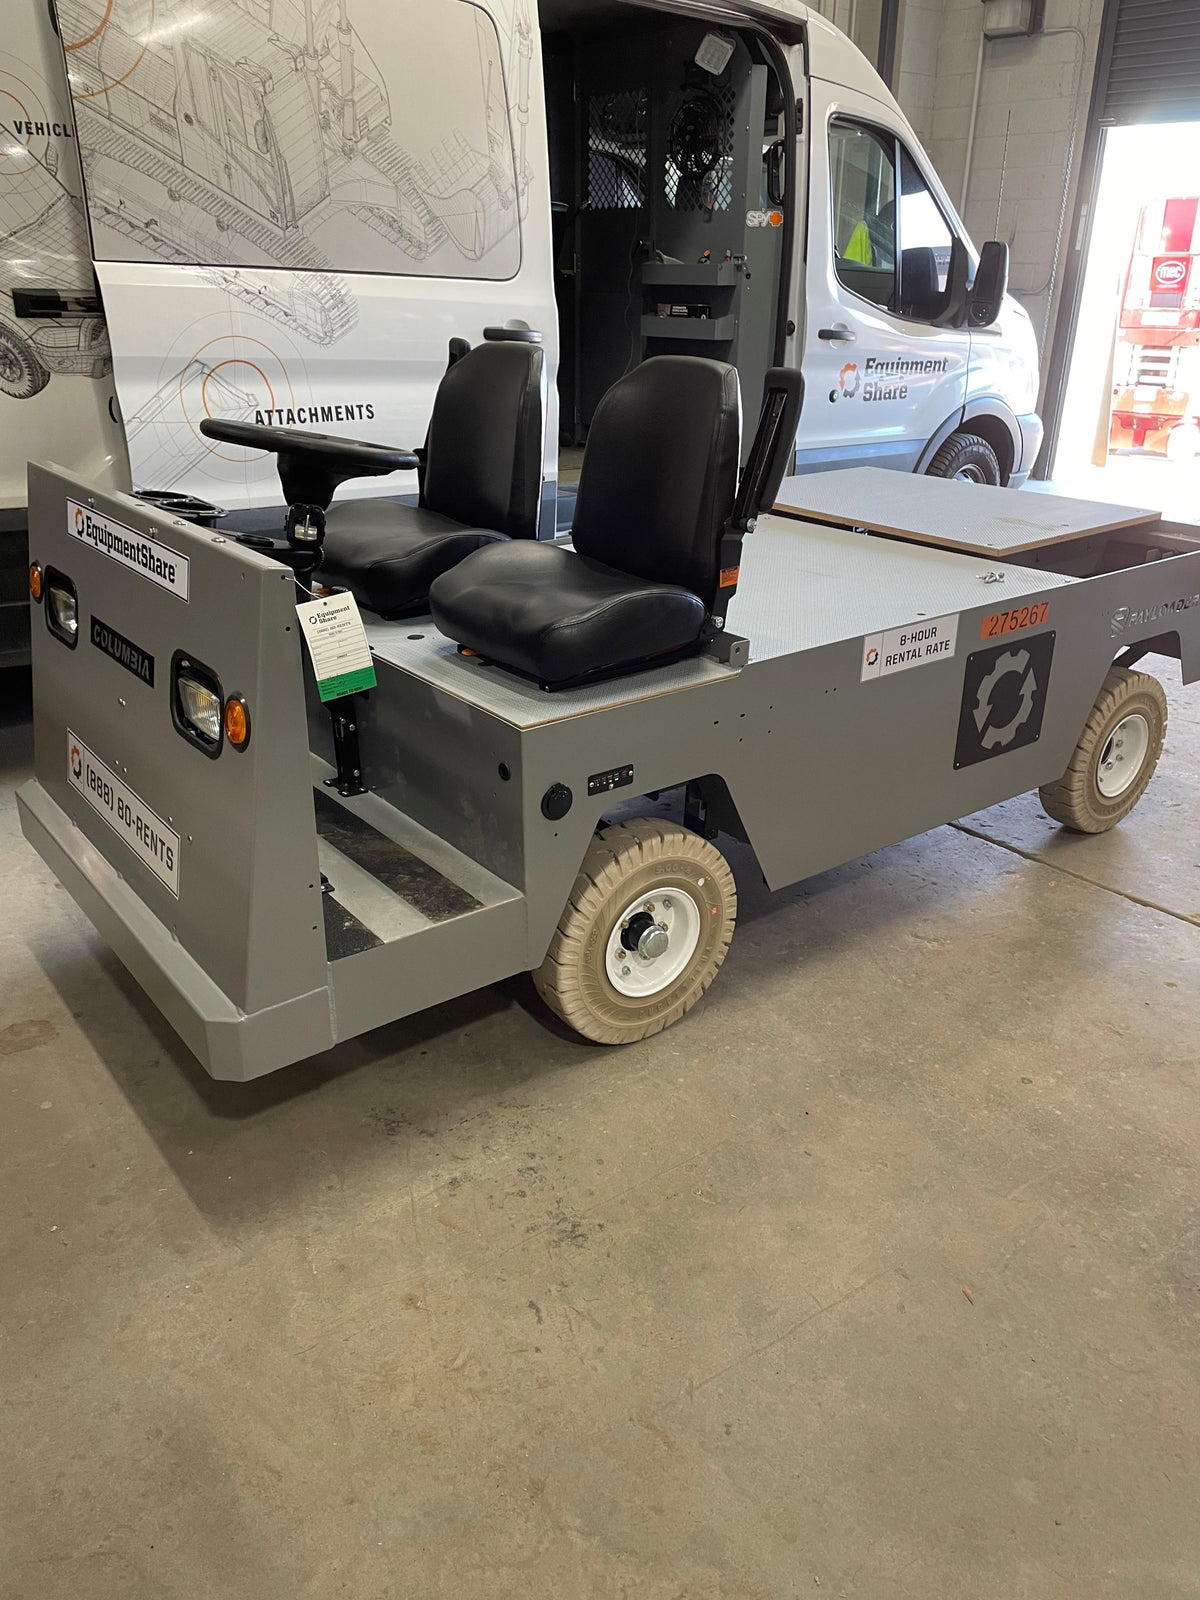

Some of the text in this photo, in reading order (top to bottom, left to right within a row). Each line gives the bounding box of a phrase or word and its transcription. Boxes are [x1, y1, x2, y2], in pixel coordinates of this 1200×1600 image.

[864, 356, 948, 381] Equipment
[863, 382, 907, 402] Share
[255, 403, 375, 425] ATTACHMENTS
[85, 515, 176, 585] EquipmentShare
[316, 605, 350, 618] Equipment
[319, 615, 338, 624] Share
[988, 602, 1049, 636] 275267
[900, 627, 938, 646] 8-HOUR
[94, 624, 149, 679] COLUMBIA
[885, 639, 950, 667] RENTAL RATE
[86, 764, 174, 872] (888) 80-RENTS
